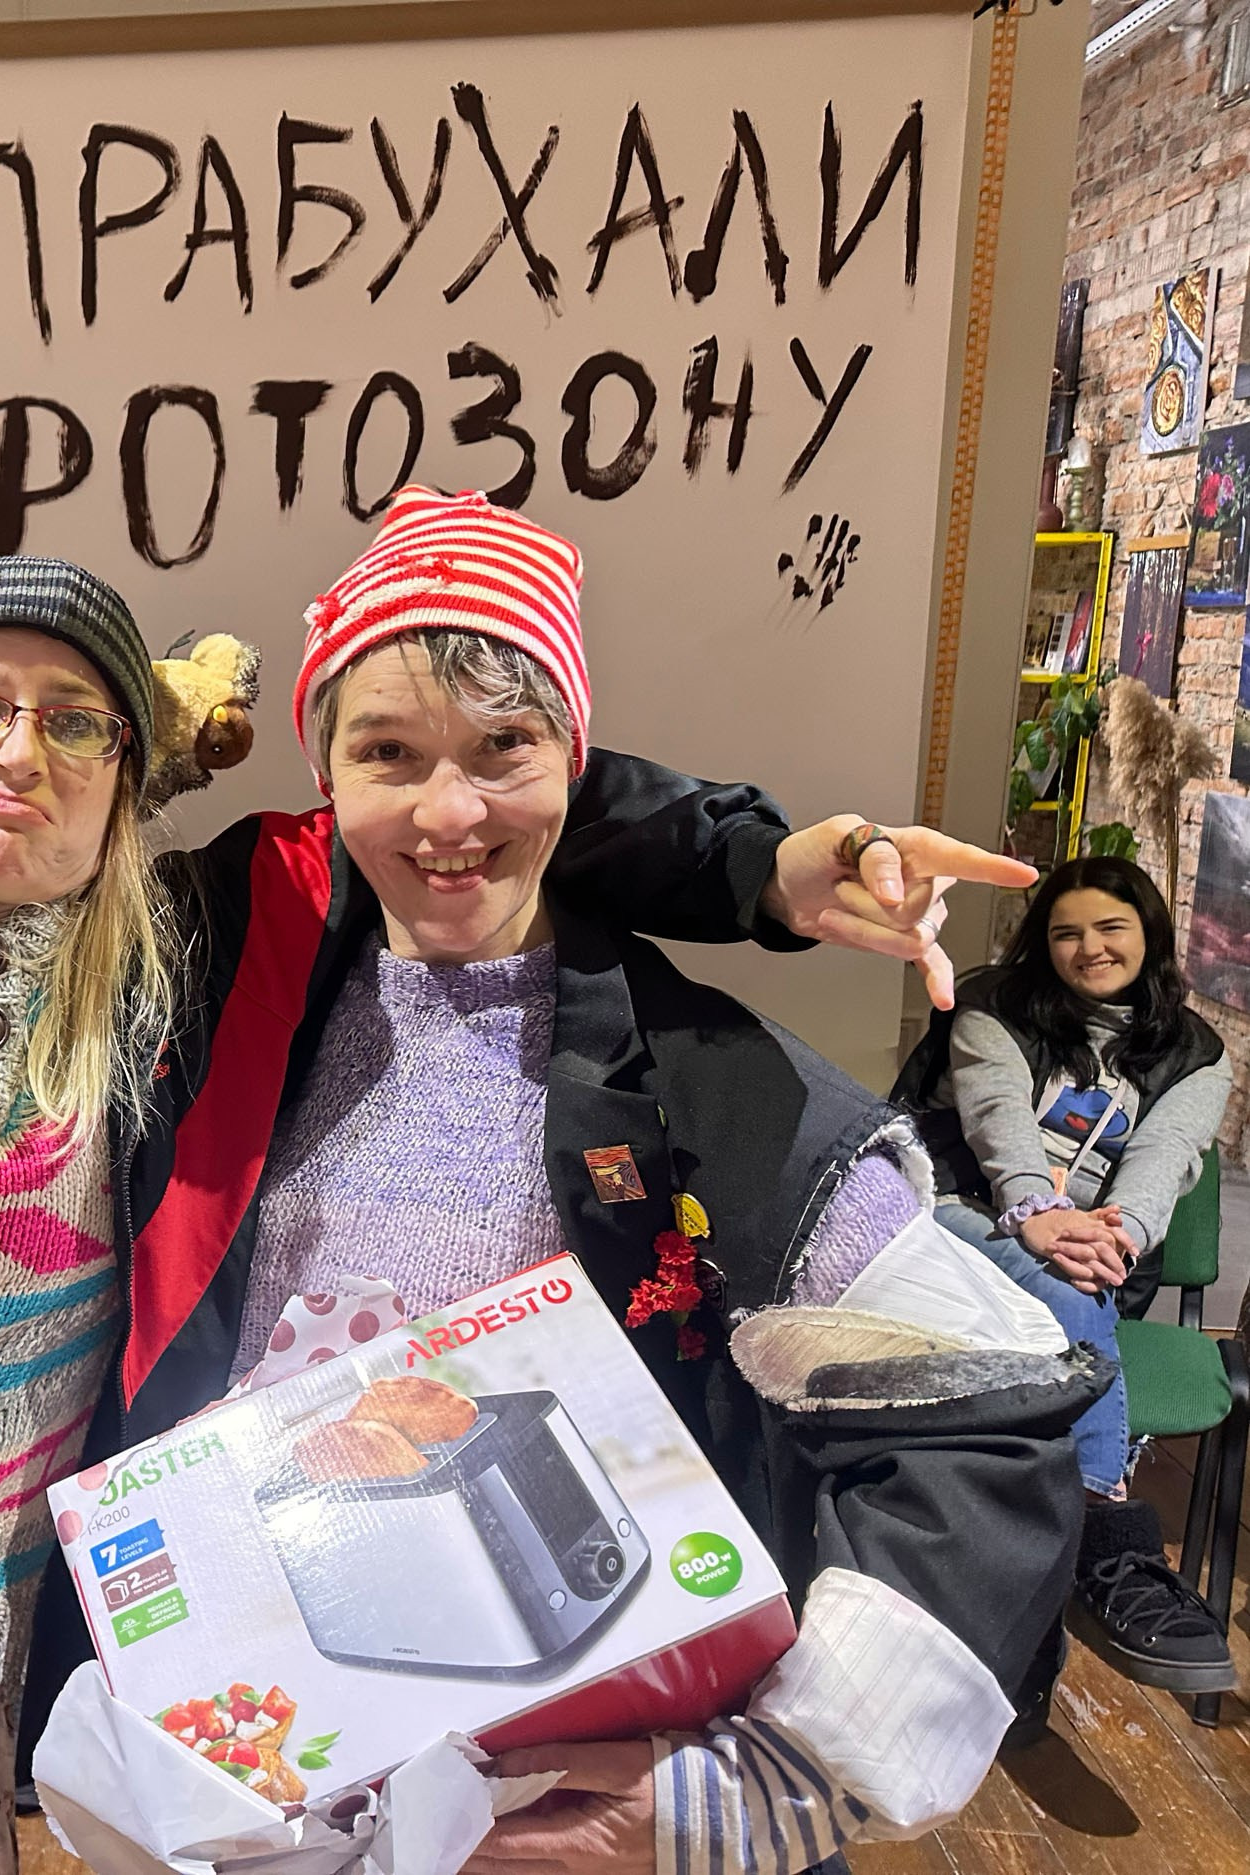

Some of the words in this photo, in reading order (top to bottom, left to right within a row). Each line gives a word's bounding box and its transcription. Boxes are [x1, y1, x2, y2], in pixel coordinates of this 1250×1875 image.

[406, 1278, 573, 1369] ARDESTO
[99, 1543, 118, 1568] 7
[119, 1537, 149, 1555] TOASTING
[121, 1547, 143, 1561] LEVELS
[677, 1551, 719, 1579] 800
[695, 1565, 730, 1585] POWER
[127, 1571, 143, 1590] 2
